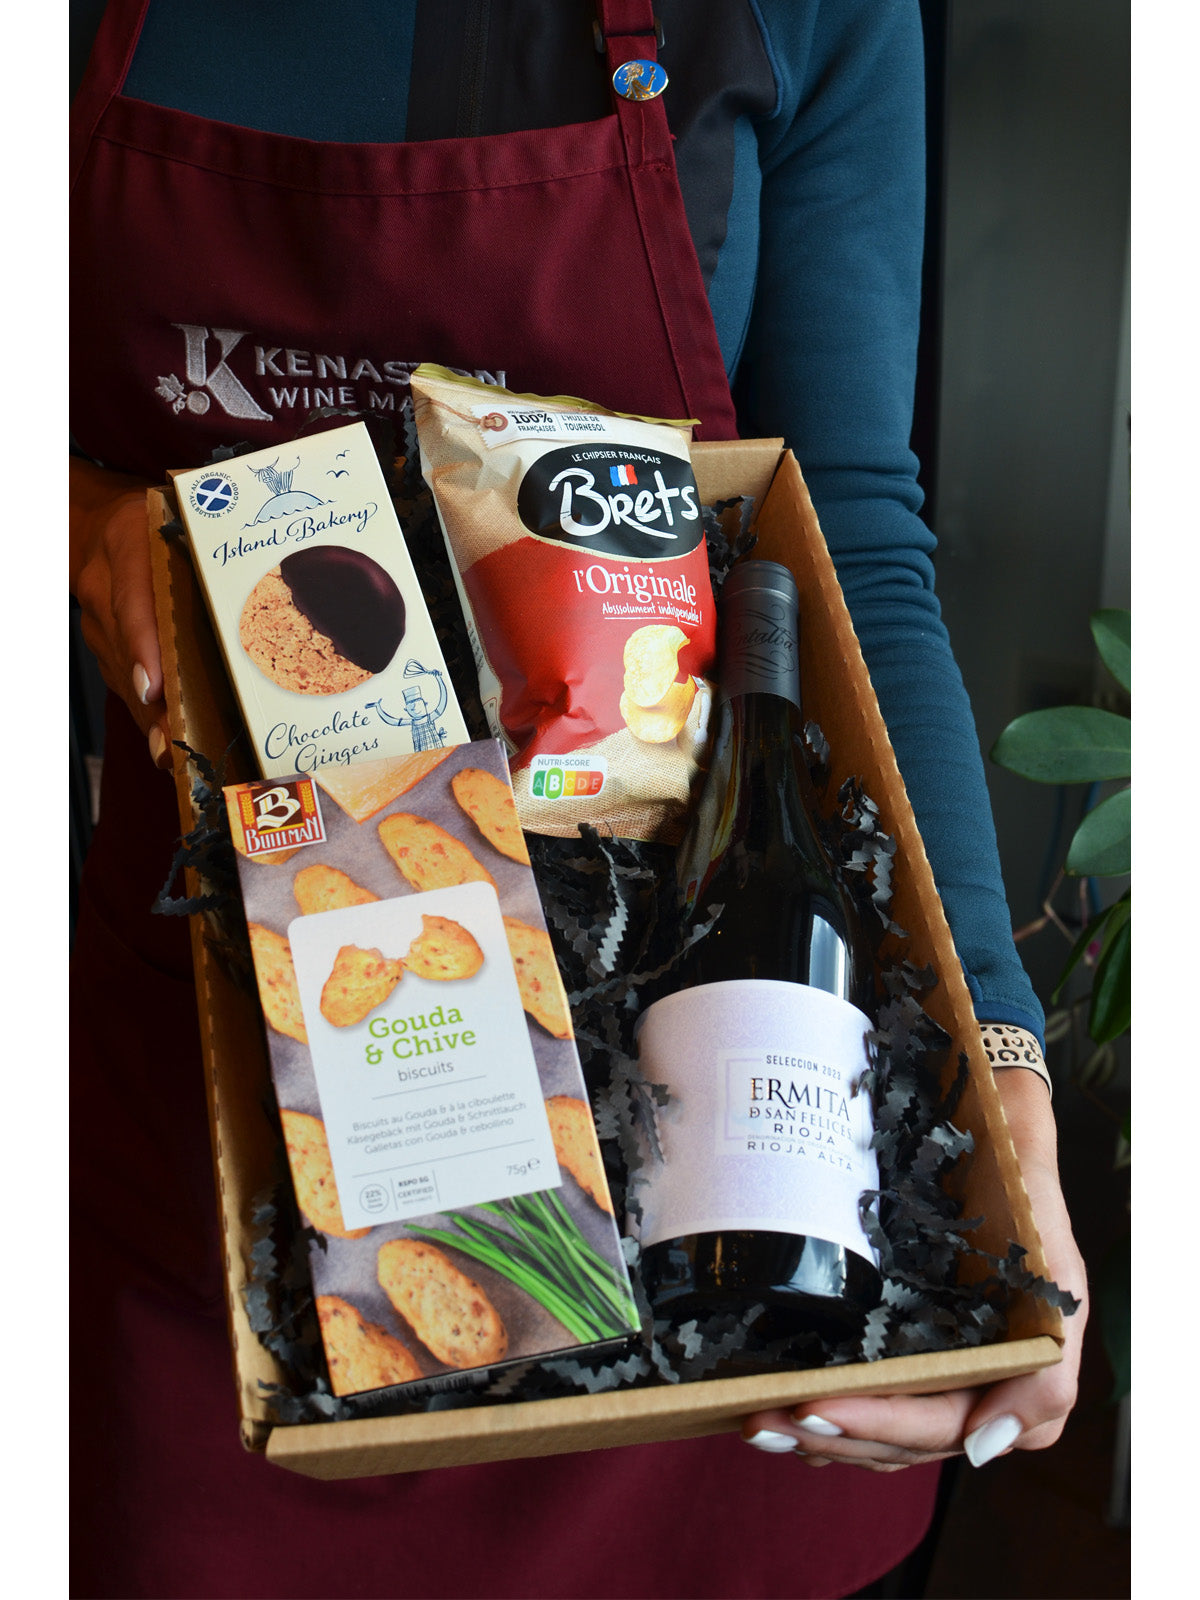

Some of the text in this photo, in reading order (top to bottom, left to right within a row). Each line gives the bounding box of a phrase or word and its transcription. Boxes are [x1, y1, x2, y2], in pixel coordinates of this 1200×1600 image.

[254, 346, 506, 389] KENASN
[269, 386, 356, 409] WINE
[512, 413, 553, 424] 100%
[518, 425, 557, 434] FRANÇAISES
[564, 423, 606, 432] TOURNESOL
[572, 451, 661, 464] LE CHIPSIER FRANÇAIS
[191, 472, 231, 491] ALL ORGANIC
[226, 482, 239, 514] ALL GOOD
[194, 506, 222, 518] BUTTER
[212, 502, 378, 567] Island Bakery
[573, 564, 696, 606] l'Originale
[265, 710, 371, 759] Chocolate
[295, 738, 379, 773] Gingers
[549, 774, 560, 791] B
[368, 1006, 464, 1038] Gouda
[365, 1029, 476, 1065] & Chive
[397, 1061, 454, 1082] biscuits
[766, 1054, 818, 1072] SELECCION
[352, 1118, 390, 1132] Biscuits
[391, 1116, 403, 1124] au
[405, 1108, 438, 1120] Gouda
[468, 1092, 516, 1108] ciboulette
[750, 1078, 850, 1122] ERMITA
[406, 1123, 421, 1132] mit
[424, 1116, 456, 1129] Gouda
[774, 1124, 835, 1145] RIOJA
[364, 1141, 402, 1154] Galletas
[405, 1137, 423, 1146] con
[425, 1129, 458, 1142] Gouda
[748, 1142, 806, 1155] RIOJA
[818, 1151, 852, 1170] ALTA
